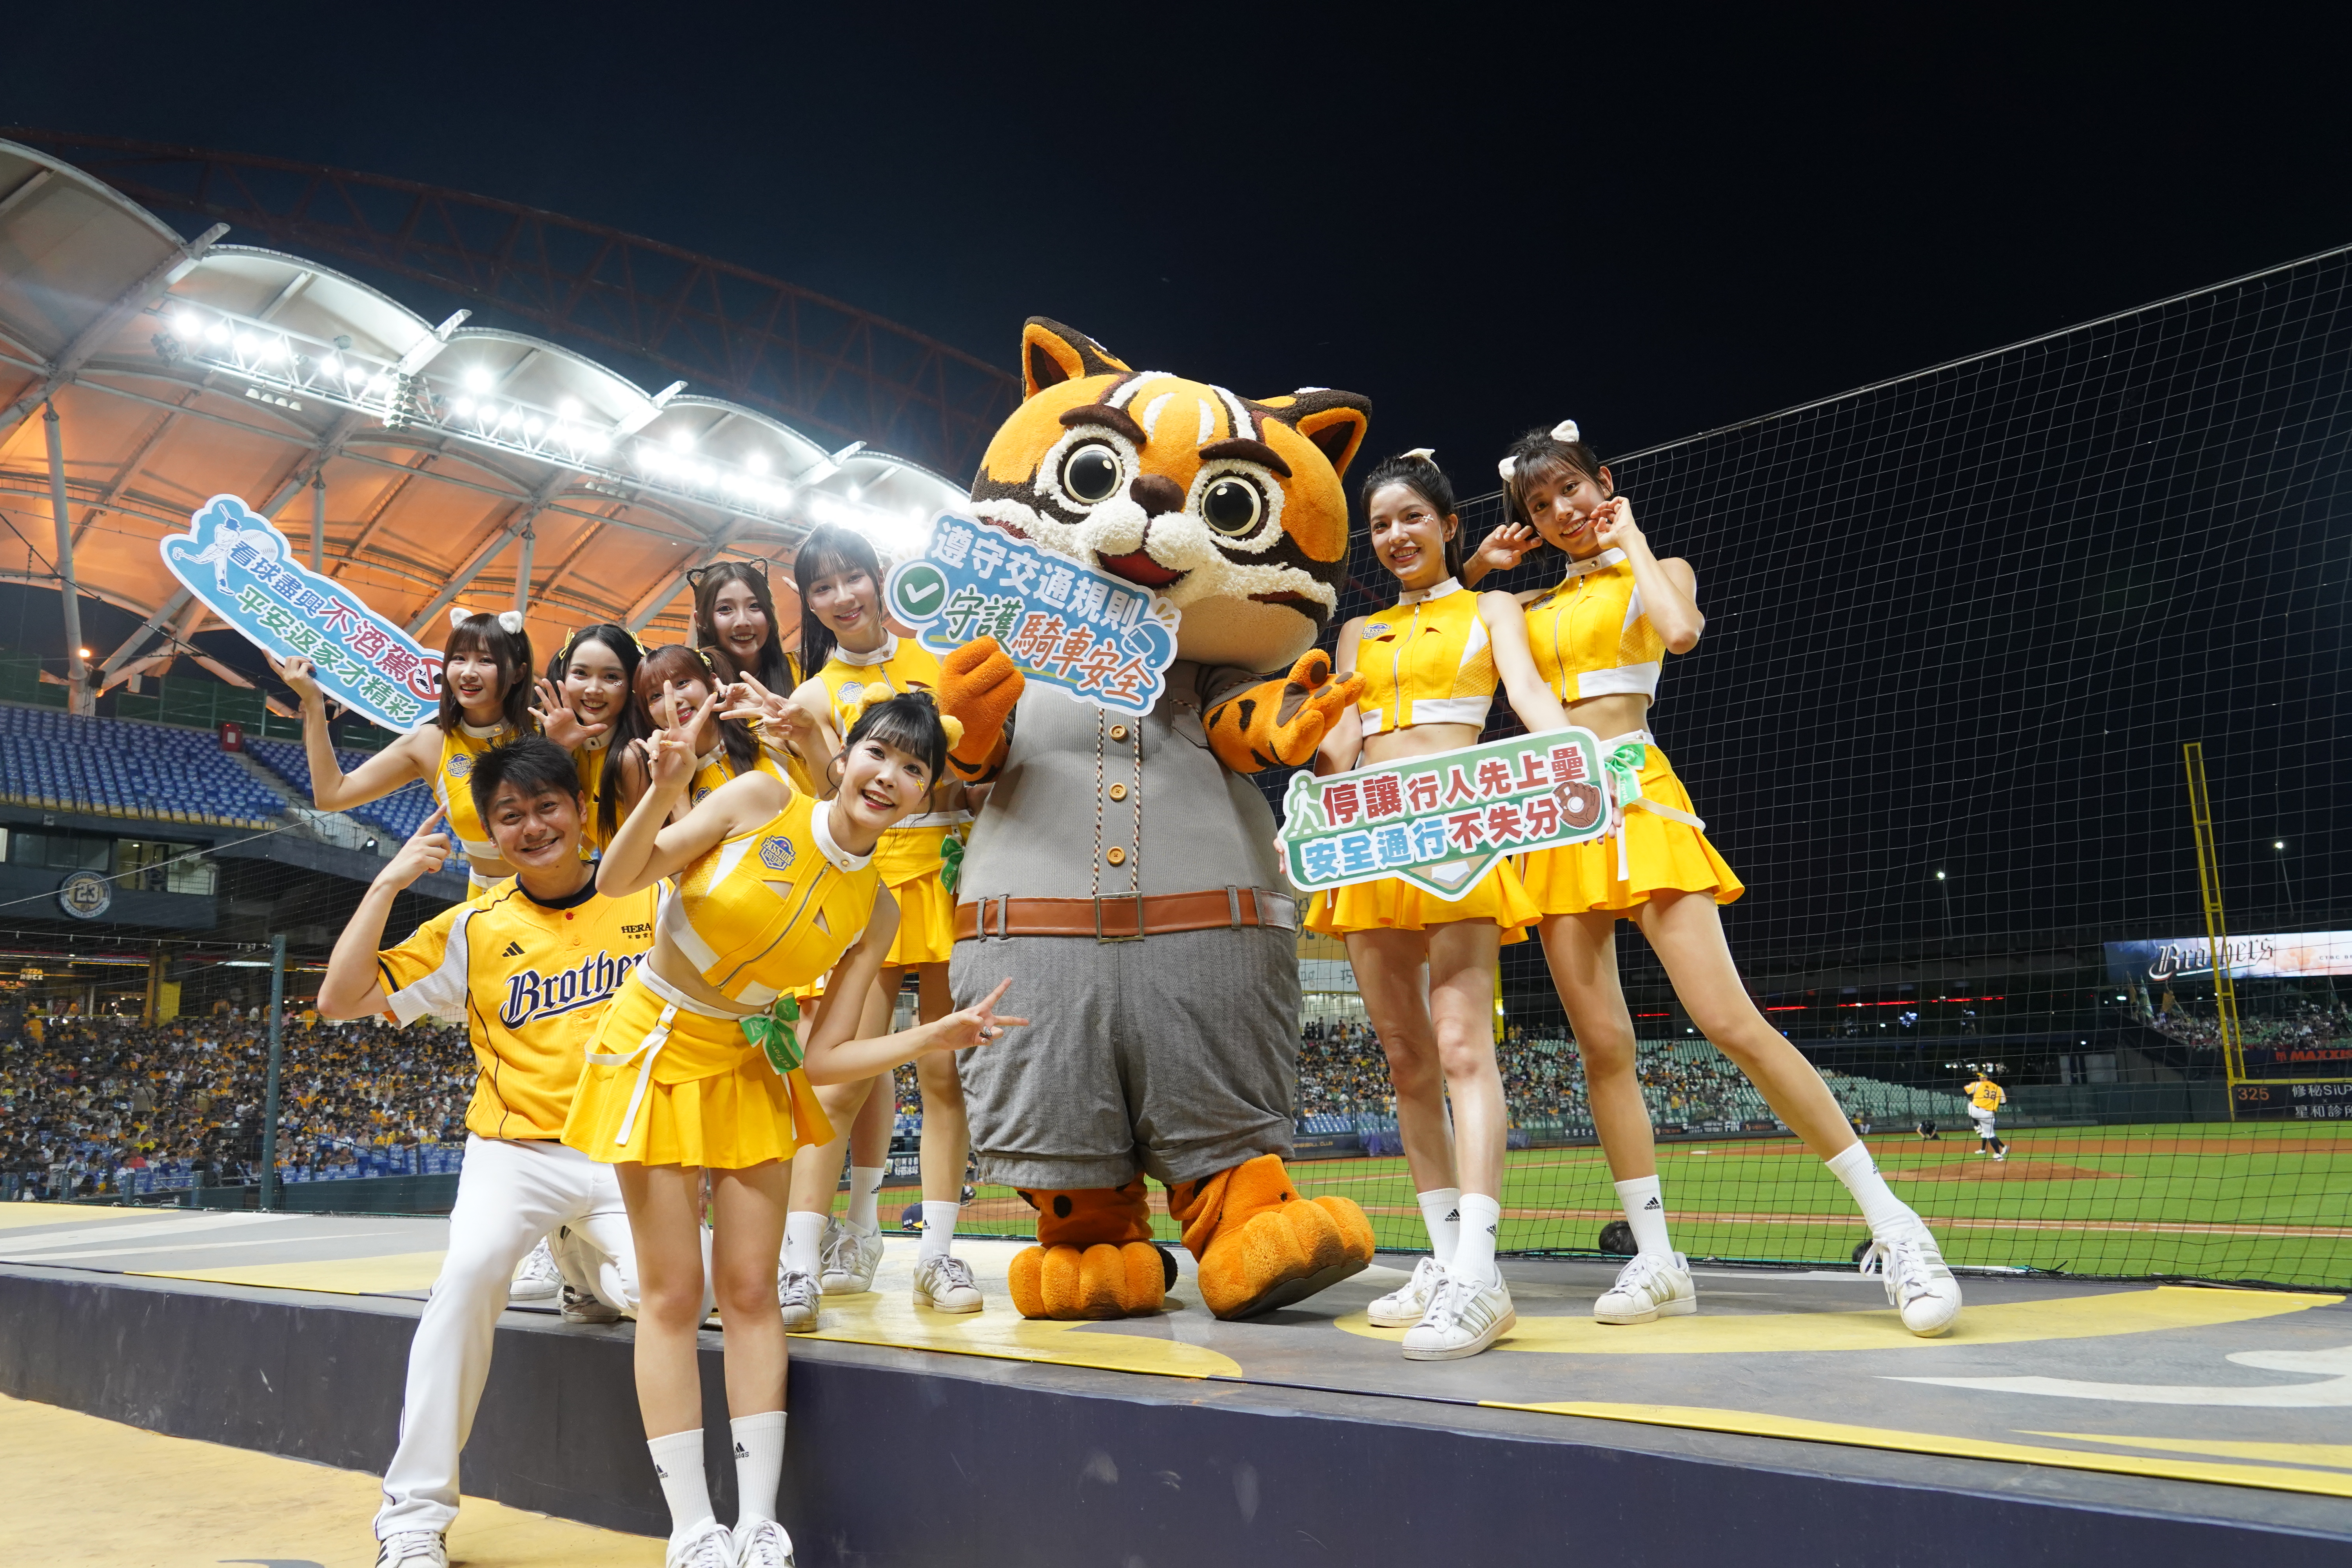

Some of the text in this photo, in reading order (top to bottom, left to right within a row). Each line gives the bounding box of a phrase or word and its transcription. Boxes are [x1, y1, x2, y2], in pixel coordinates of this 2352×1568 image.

[931, 522, 1143, 634] 遵守交通規則
[228, 541, 420, 682] 看球盡興不酒駕
[236, 586, 421, 722] 平安返家才精彩
[945, 587, 1152, 702] 守護騎車安全
[447, 759, 470, 769] PASSION
[1323, 746, 1587, 827] 停讓行人先上壘
[762, 839, 794, 865] PASSION
[1305, 799, 1561, 880] 安全通行不失分
[764, 850, 784, 866] SISTERS
[77, 883, 99, 902] 23
[621, 923, 652, 933] HERA
[2149, 937, 2275, 980] Brohers
[1984, 1089, 1996, 1100] 32
[2238, 1087, 2270, 1100] 325
